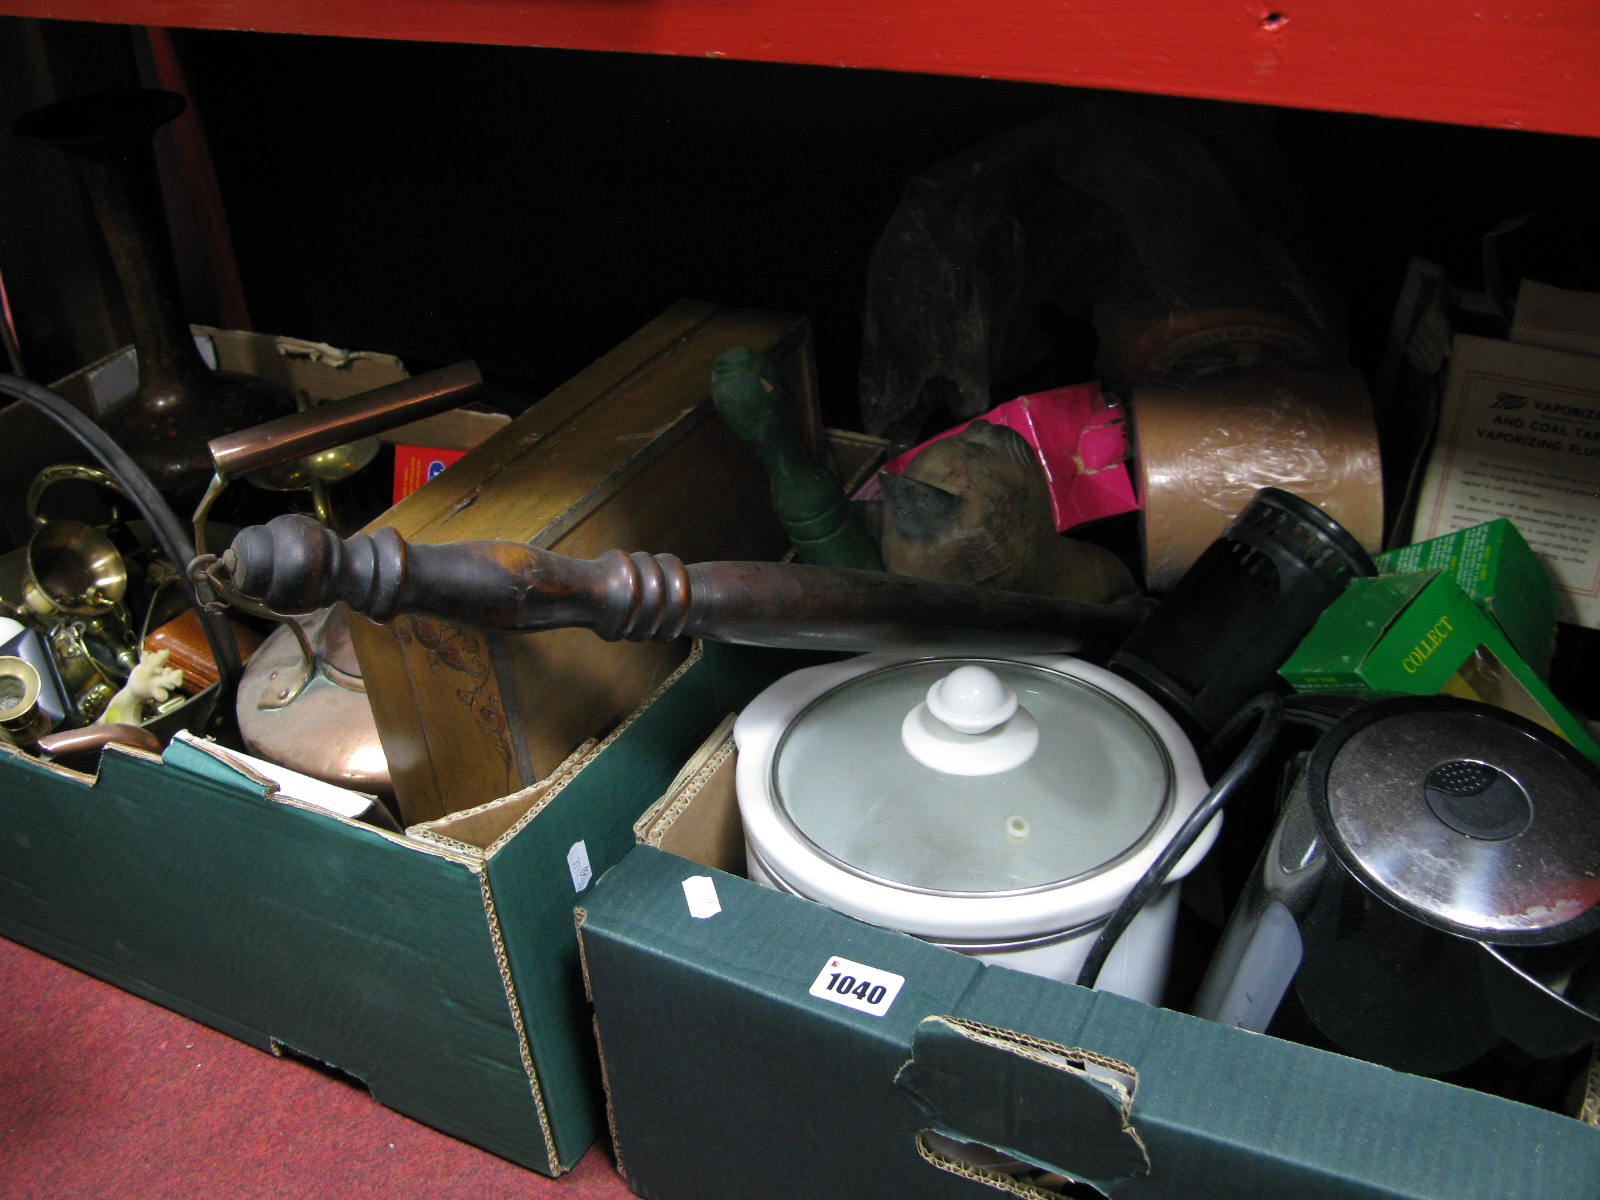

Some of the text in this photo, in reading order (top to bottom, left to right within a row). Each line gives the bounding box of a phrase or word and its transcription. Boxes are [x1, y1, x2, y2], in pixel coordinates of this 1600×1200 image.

[1493, 415, 1525, 428] AND
[1530, 420, 1568, 436] COAL
[1477, 428, 1600, 457] VAPORIZING FLUI
[1402, 616, 1454, 674] COLLECT
[826, 972, 887, 1005] 1040
